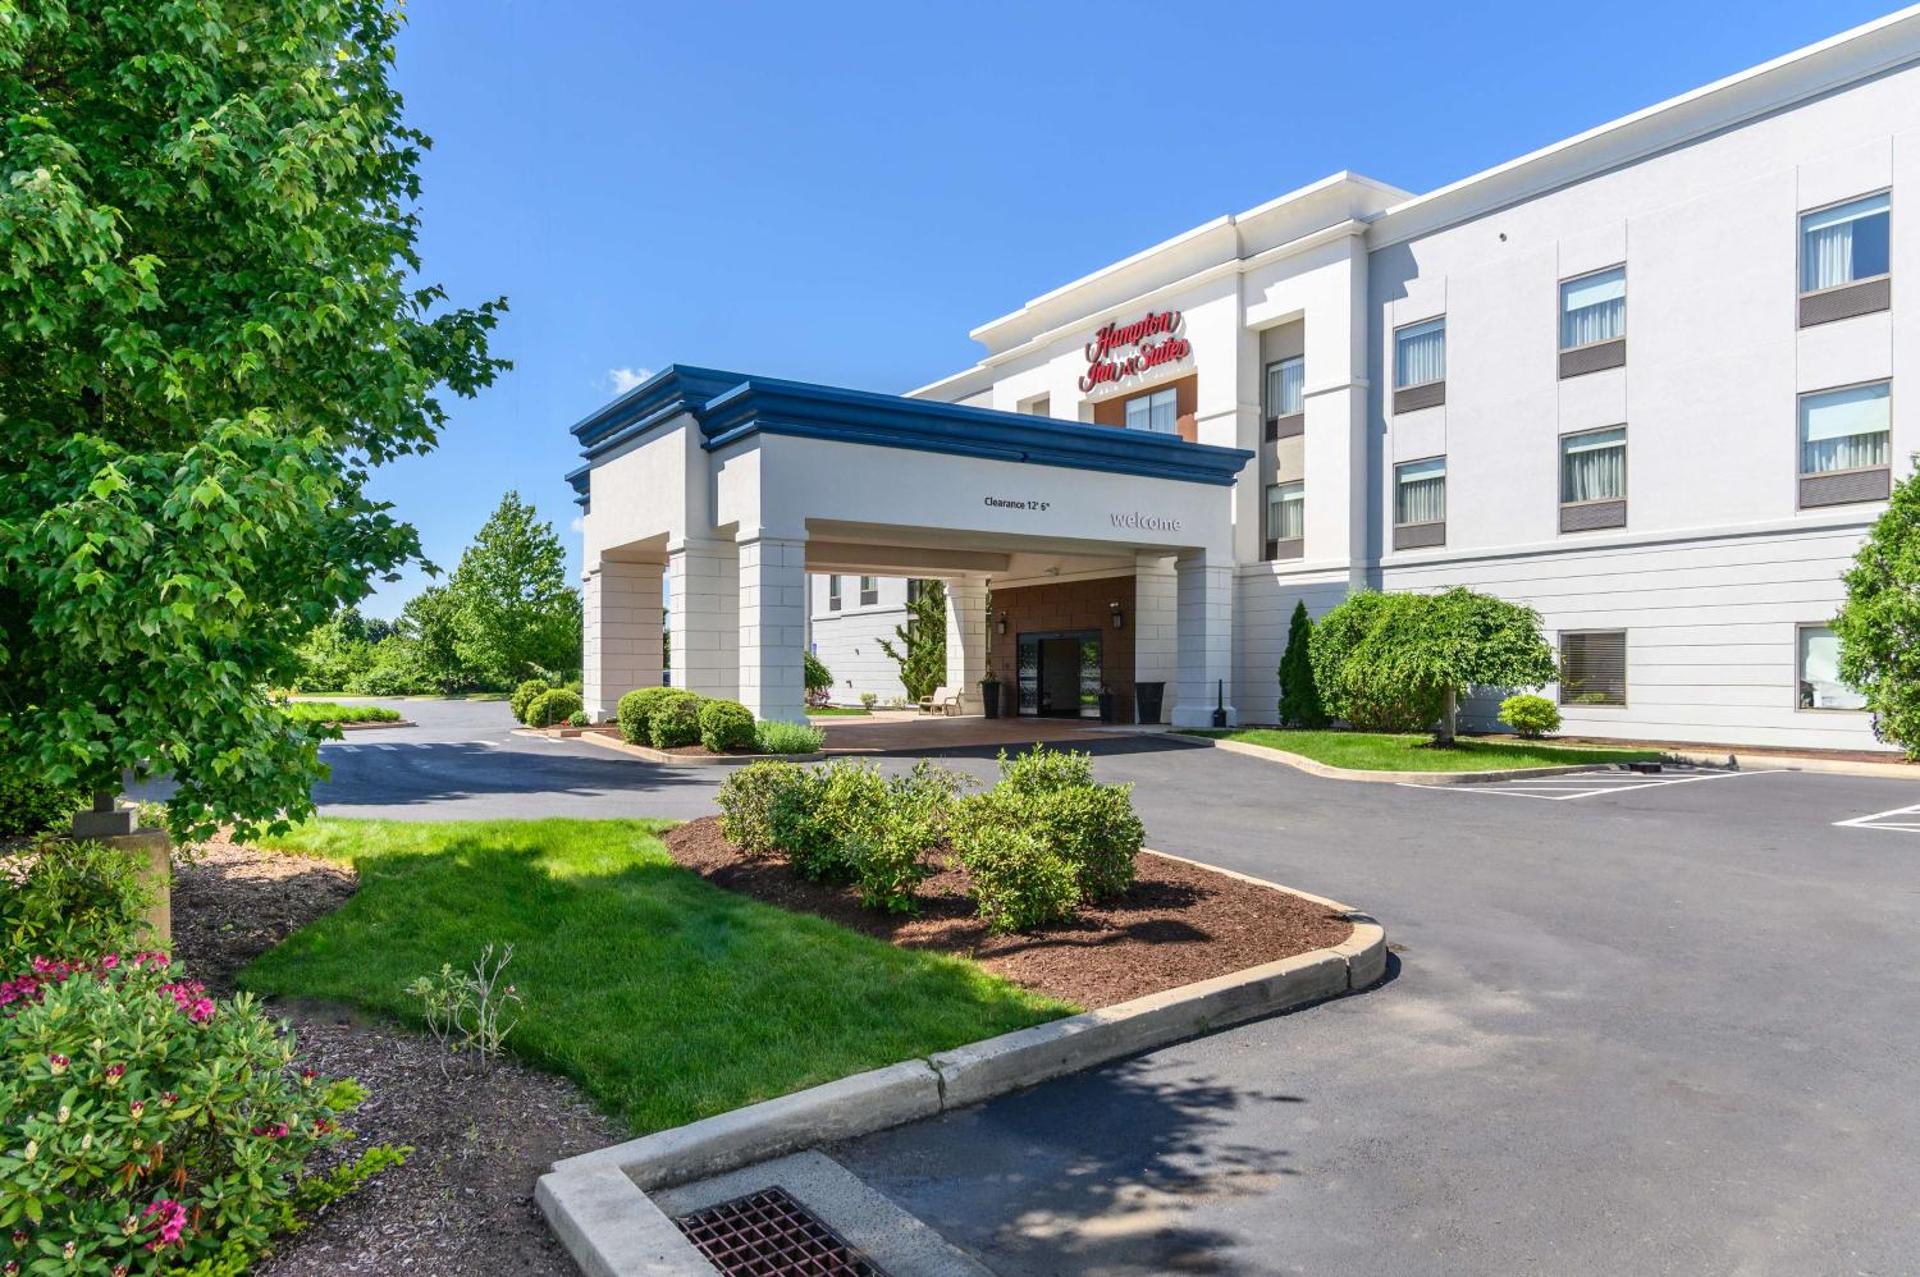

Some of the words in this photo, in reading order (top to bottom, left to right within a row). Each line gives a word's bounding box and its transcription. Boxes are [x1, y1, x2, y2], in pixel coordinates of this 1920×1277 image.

[1085, 310, 1181, 363] Hampton
[1078, 360, 1125, 392] Inn
[1133, 337, 1190, 372] Suites
[984, 496, 1025, 510] Clearance
[1027, 500, 1039, 510] 12'
[1110, 511, 1183, 532] welcome
